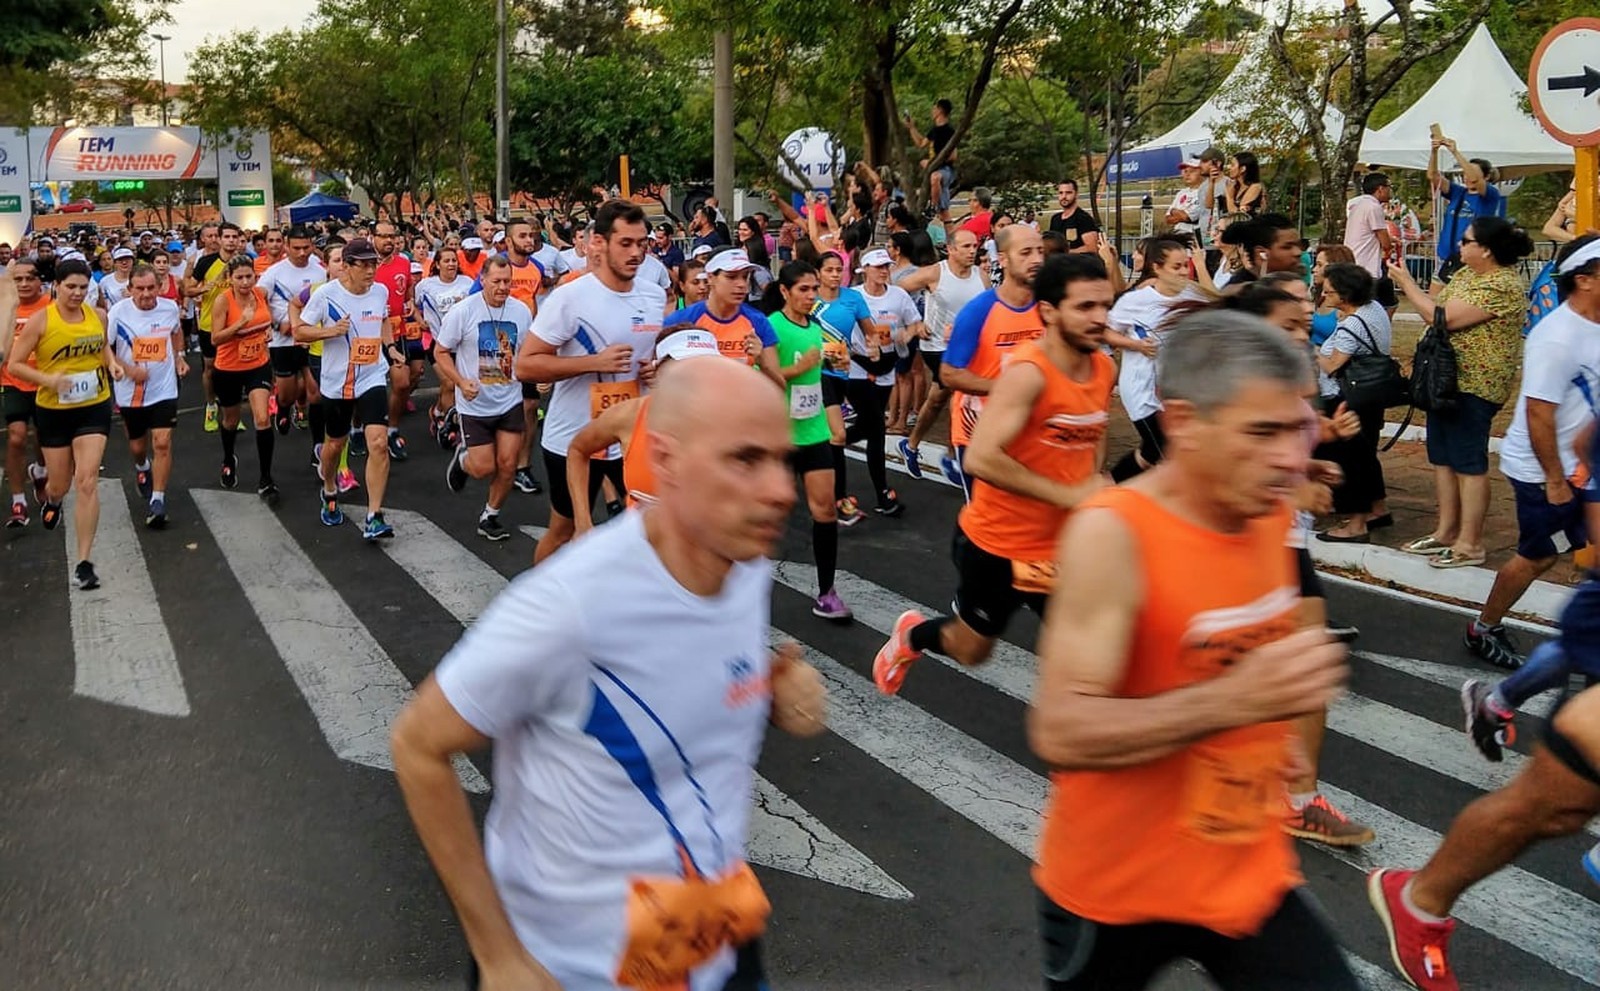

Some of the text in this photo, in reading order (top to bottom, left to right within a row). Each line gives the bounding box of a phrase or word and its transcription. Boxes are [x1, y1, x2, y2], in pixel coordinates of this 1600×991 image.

[78, 137, 115, 153] TEM
[76, 153, 177, 171] RUNNING
[242, 162, 261, 171] TEM
[0, 166, 17, 175] EM
[139, 343, 159, 354] 700
